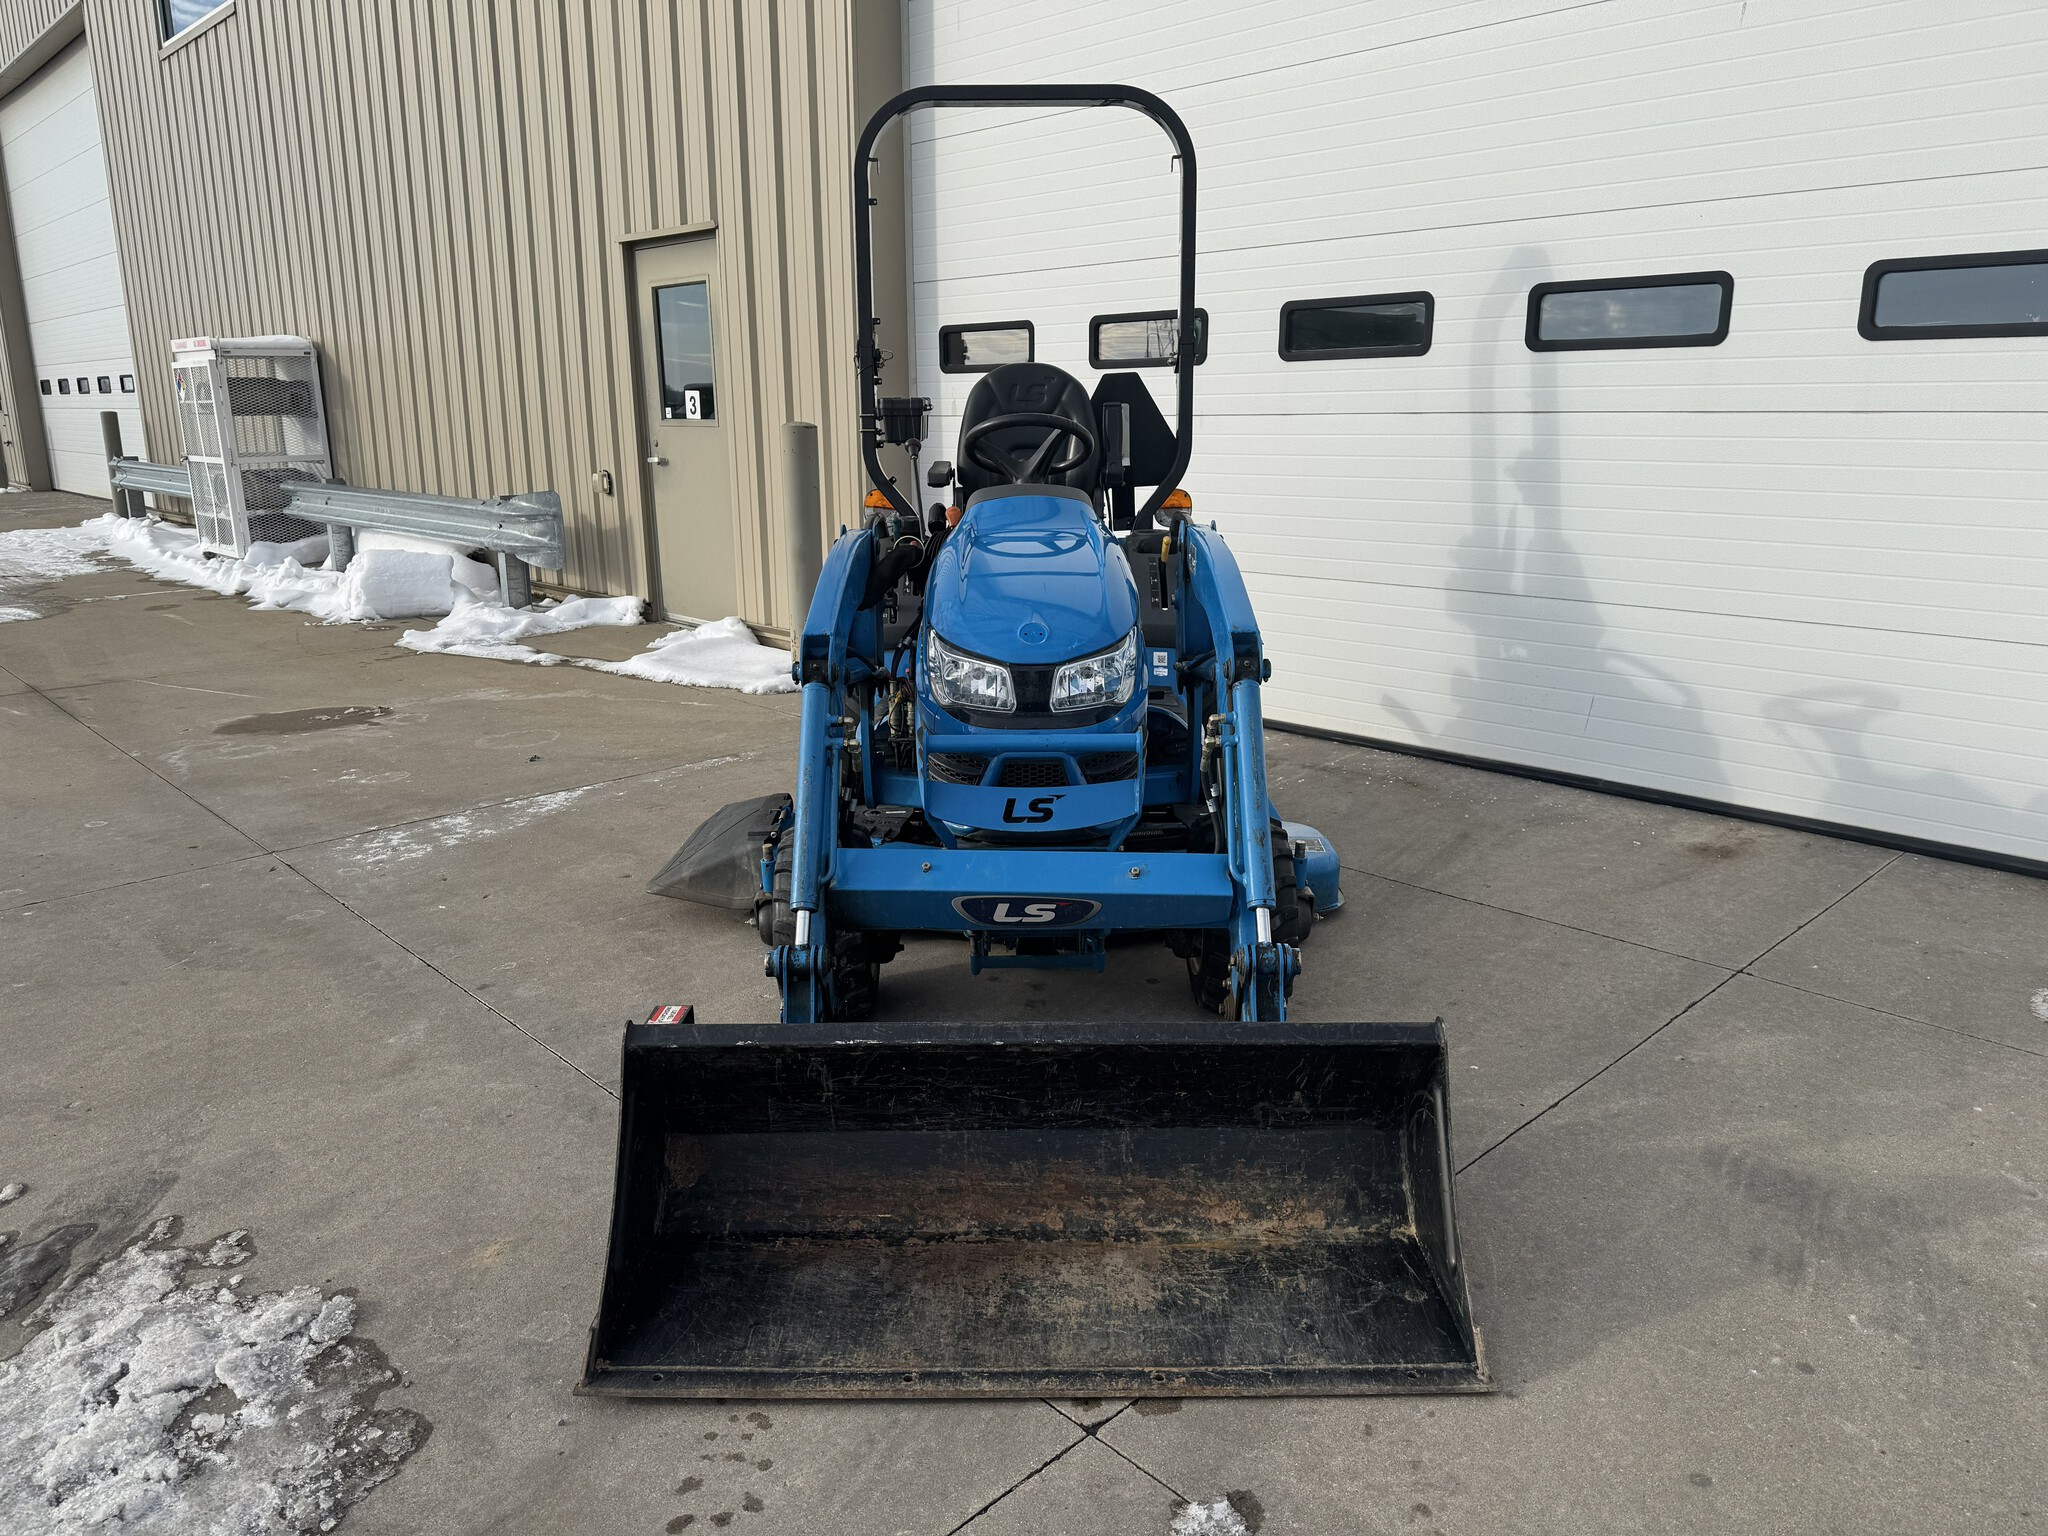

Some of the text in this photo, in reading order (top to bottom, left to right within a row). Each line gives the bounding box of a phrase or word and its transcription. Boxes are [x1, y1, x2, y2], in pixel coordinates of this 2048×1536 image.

[689, 395, 697, 415] 3
[1010, 384, 1048, 406] LS
[1002, 797, 1055, 824] LS
[993, 903, 1057, 923] LS
